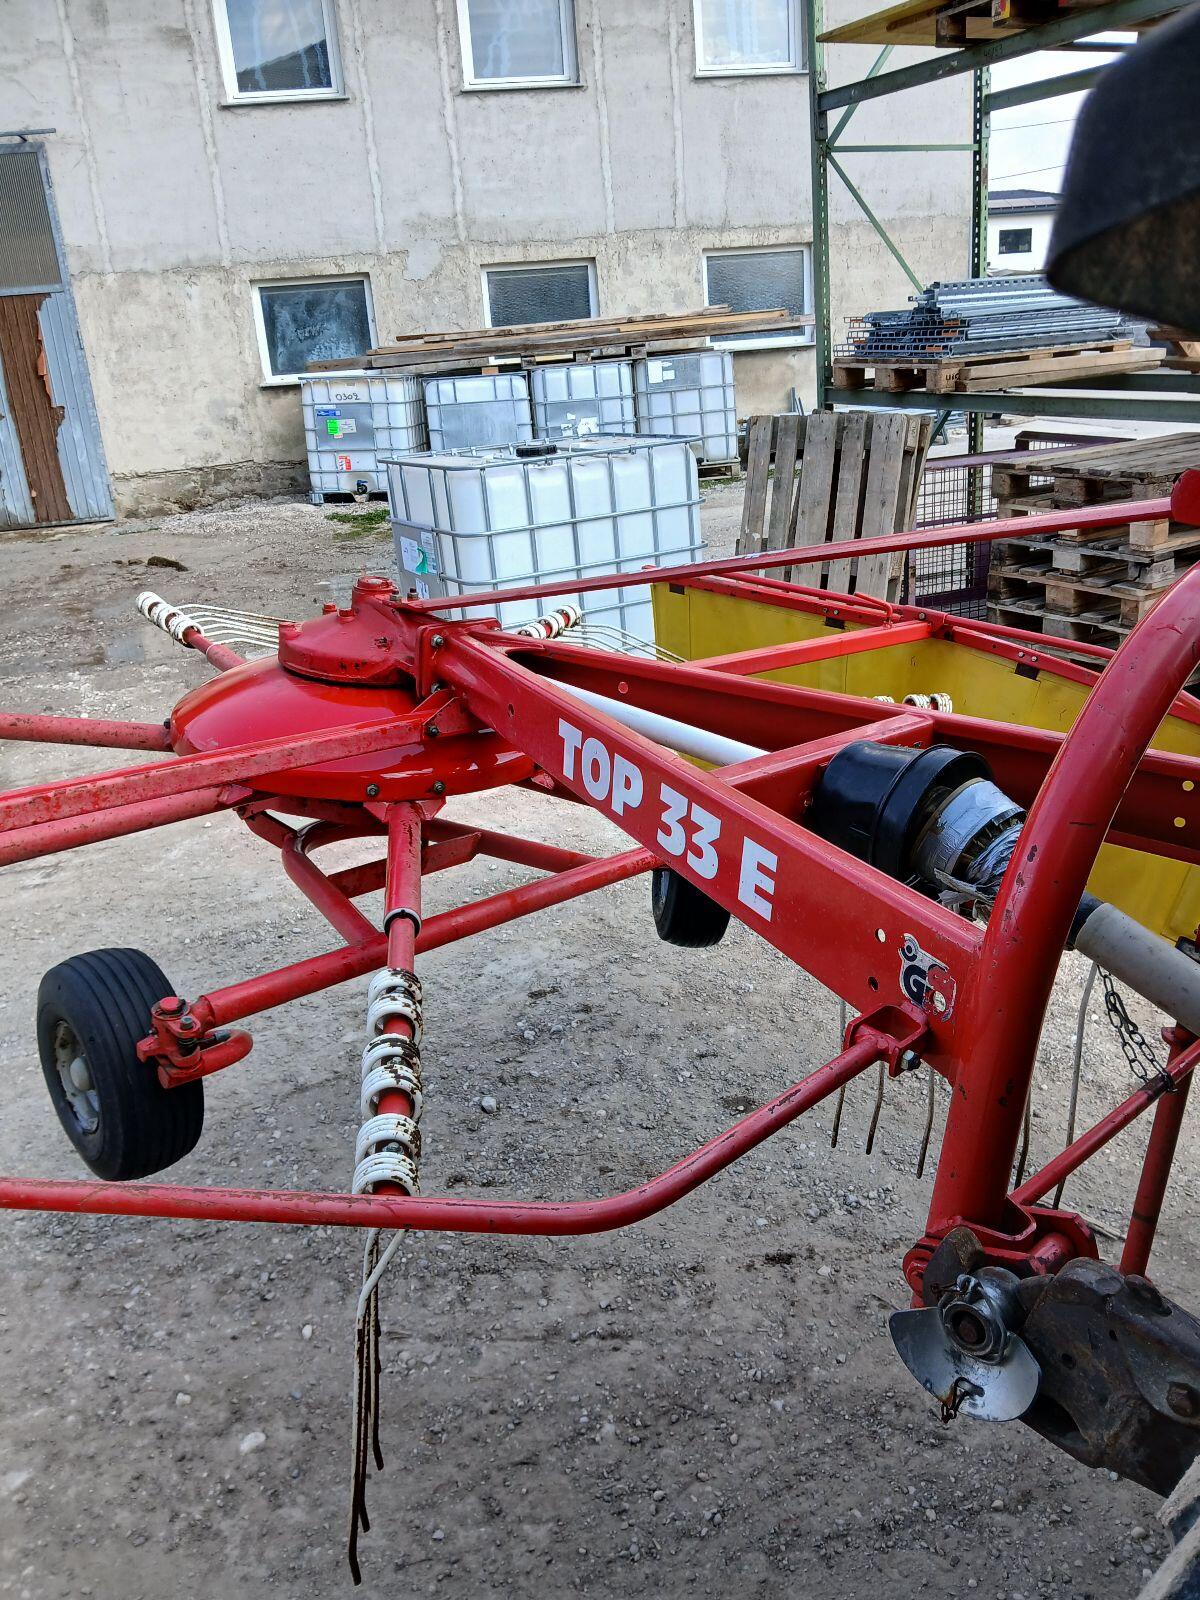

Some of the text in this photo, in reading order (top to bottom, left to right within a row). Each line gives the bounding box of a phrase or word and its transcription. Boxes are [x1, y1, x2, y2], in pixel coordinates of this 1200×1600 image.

[557, 717, 778, 923] TOP 33 E
